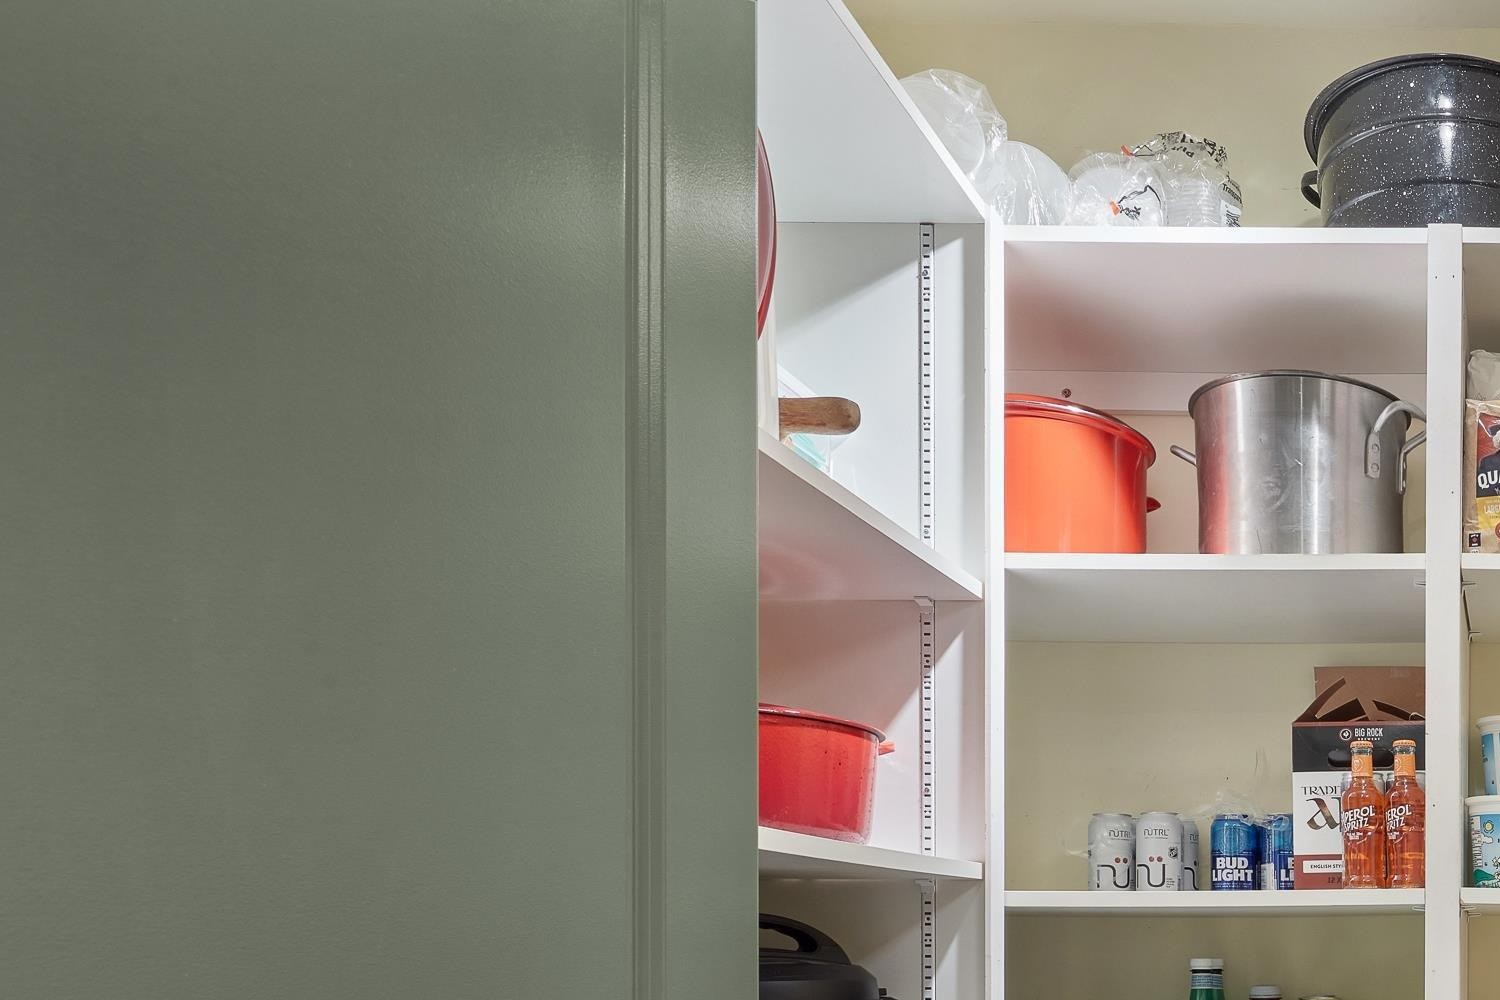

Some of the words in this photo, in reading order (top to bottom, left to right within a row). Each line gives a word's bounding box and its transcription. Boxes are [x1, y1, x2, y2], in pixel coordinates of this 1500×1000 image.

[1366, 727, 1383, 737] ROCK
[1216, 857, 1249, 870] BUD
[1212, 869, 1253, 882] LIGHT
